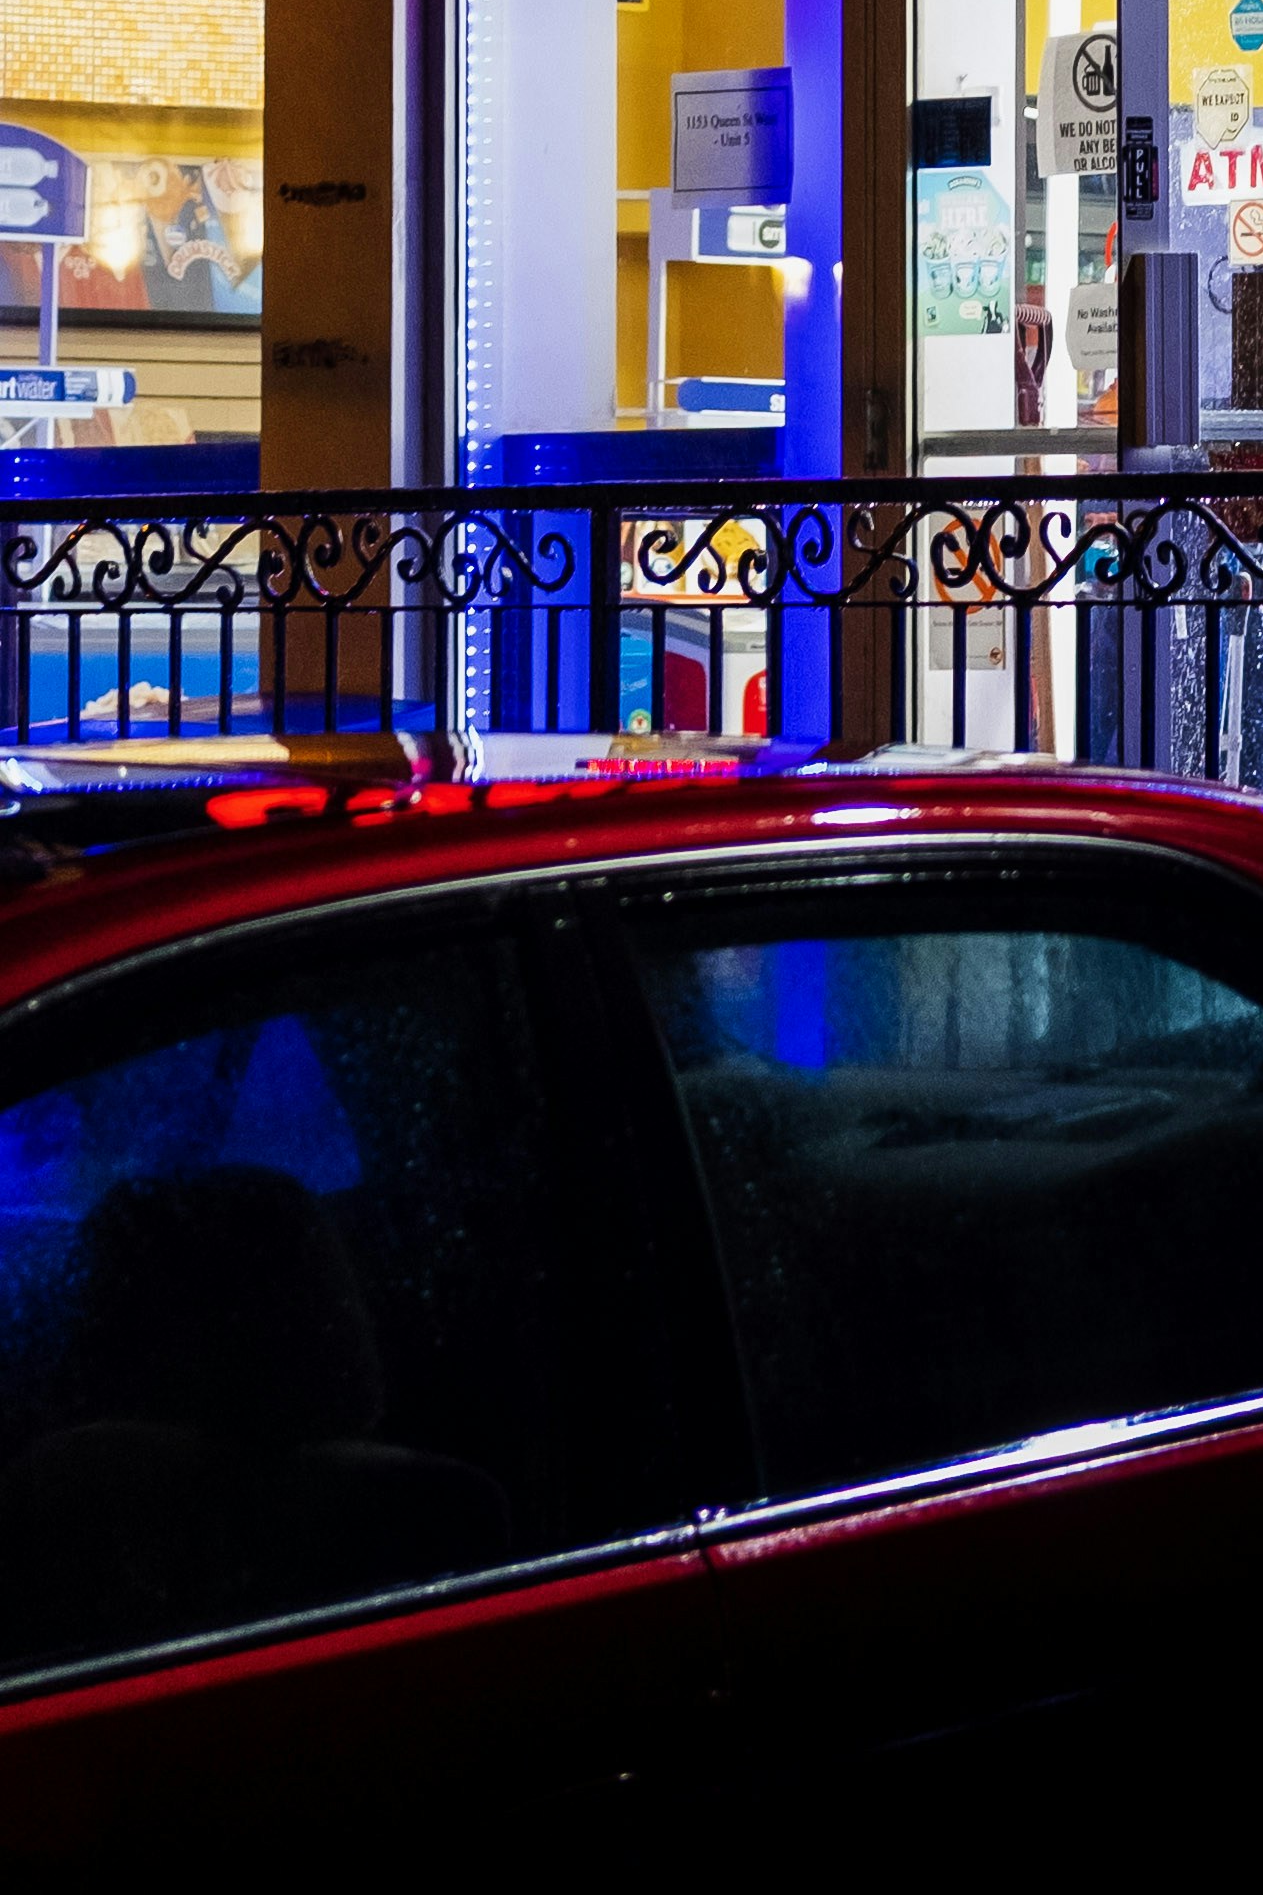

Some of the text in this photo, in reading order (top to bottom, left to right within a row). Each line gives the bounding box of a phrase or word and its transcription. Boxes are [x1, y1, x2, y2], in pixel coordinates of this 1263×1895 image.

[1060, 119, 1116, 138] WE DO NOT
[1079, 139, 1099, 154] ANY
[1073, 158, 1087, 172] OR
[1136, 149, 1145, 199] PULL
[1077, 308, 1088, 320] No
